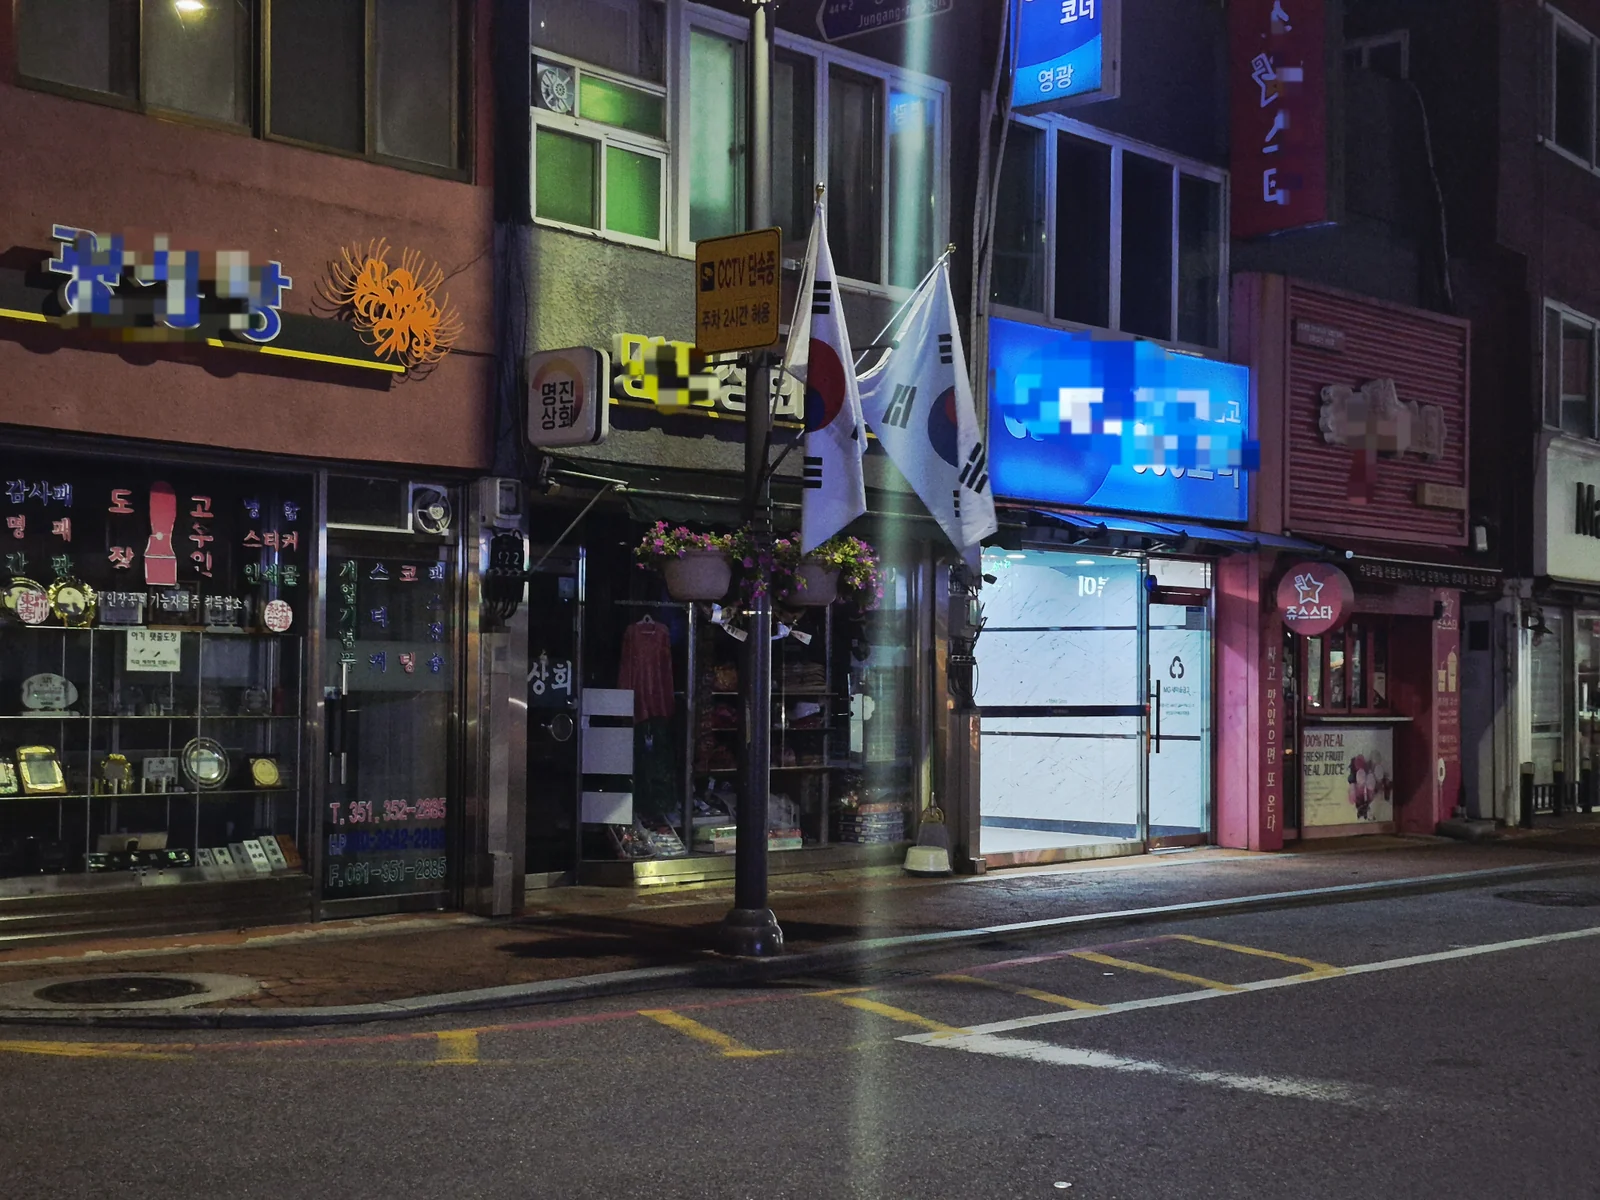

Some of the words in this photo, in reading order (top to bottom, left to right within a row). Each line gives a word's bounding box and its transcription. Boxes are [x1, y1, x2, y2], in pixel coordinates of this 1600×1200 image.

[1060, 0, 1095, 24] 코너
[1038, 64, 1074, 93] 영광
[717, 255, 745, 289] CCTV
[748, 250, 775, 288] 단속중
[701, 308, 720, 331] 주차
[723, 305, 749, 328] 2시간
[751, 301, 771, 325] 허용
[541, 380, 574, 406] 명진
[541, 405, 575, 430] 상회
[5, 478, 73, 508] 감사패
[108, 488, 135, 570] 도장
[242, 529, 299, 552] 스티커
[150, 592, 201, 609] 기능자격증
[1286, 605, 1334, 620] 쥬스스타
[527, 659, 573, 696] 상회
[1266, 688, 1276, 764] 맛있으면
[1323, 733, 1344, 747] REAL
[1266, 771, 1276, 787] 또
[1322, 763, 1345, 776] JUICE
[1266, 794, 1276, 832] 온다
